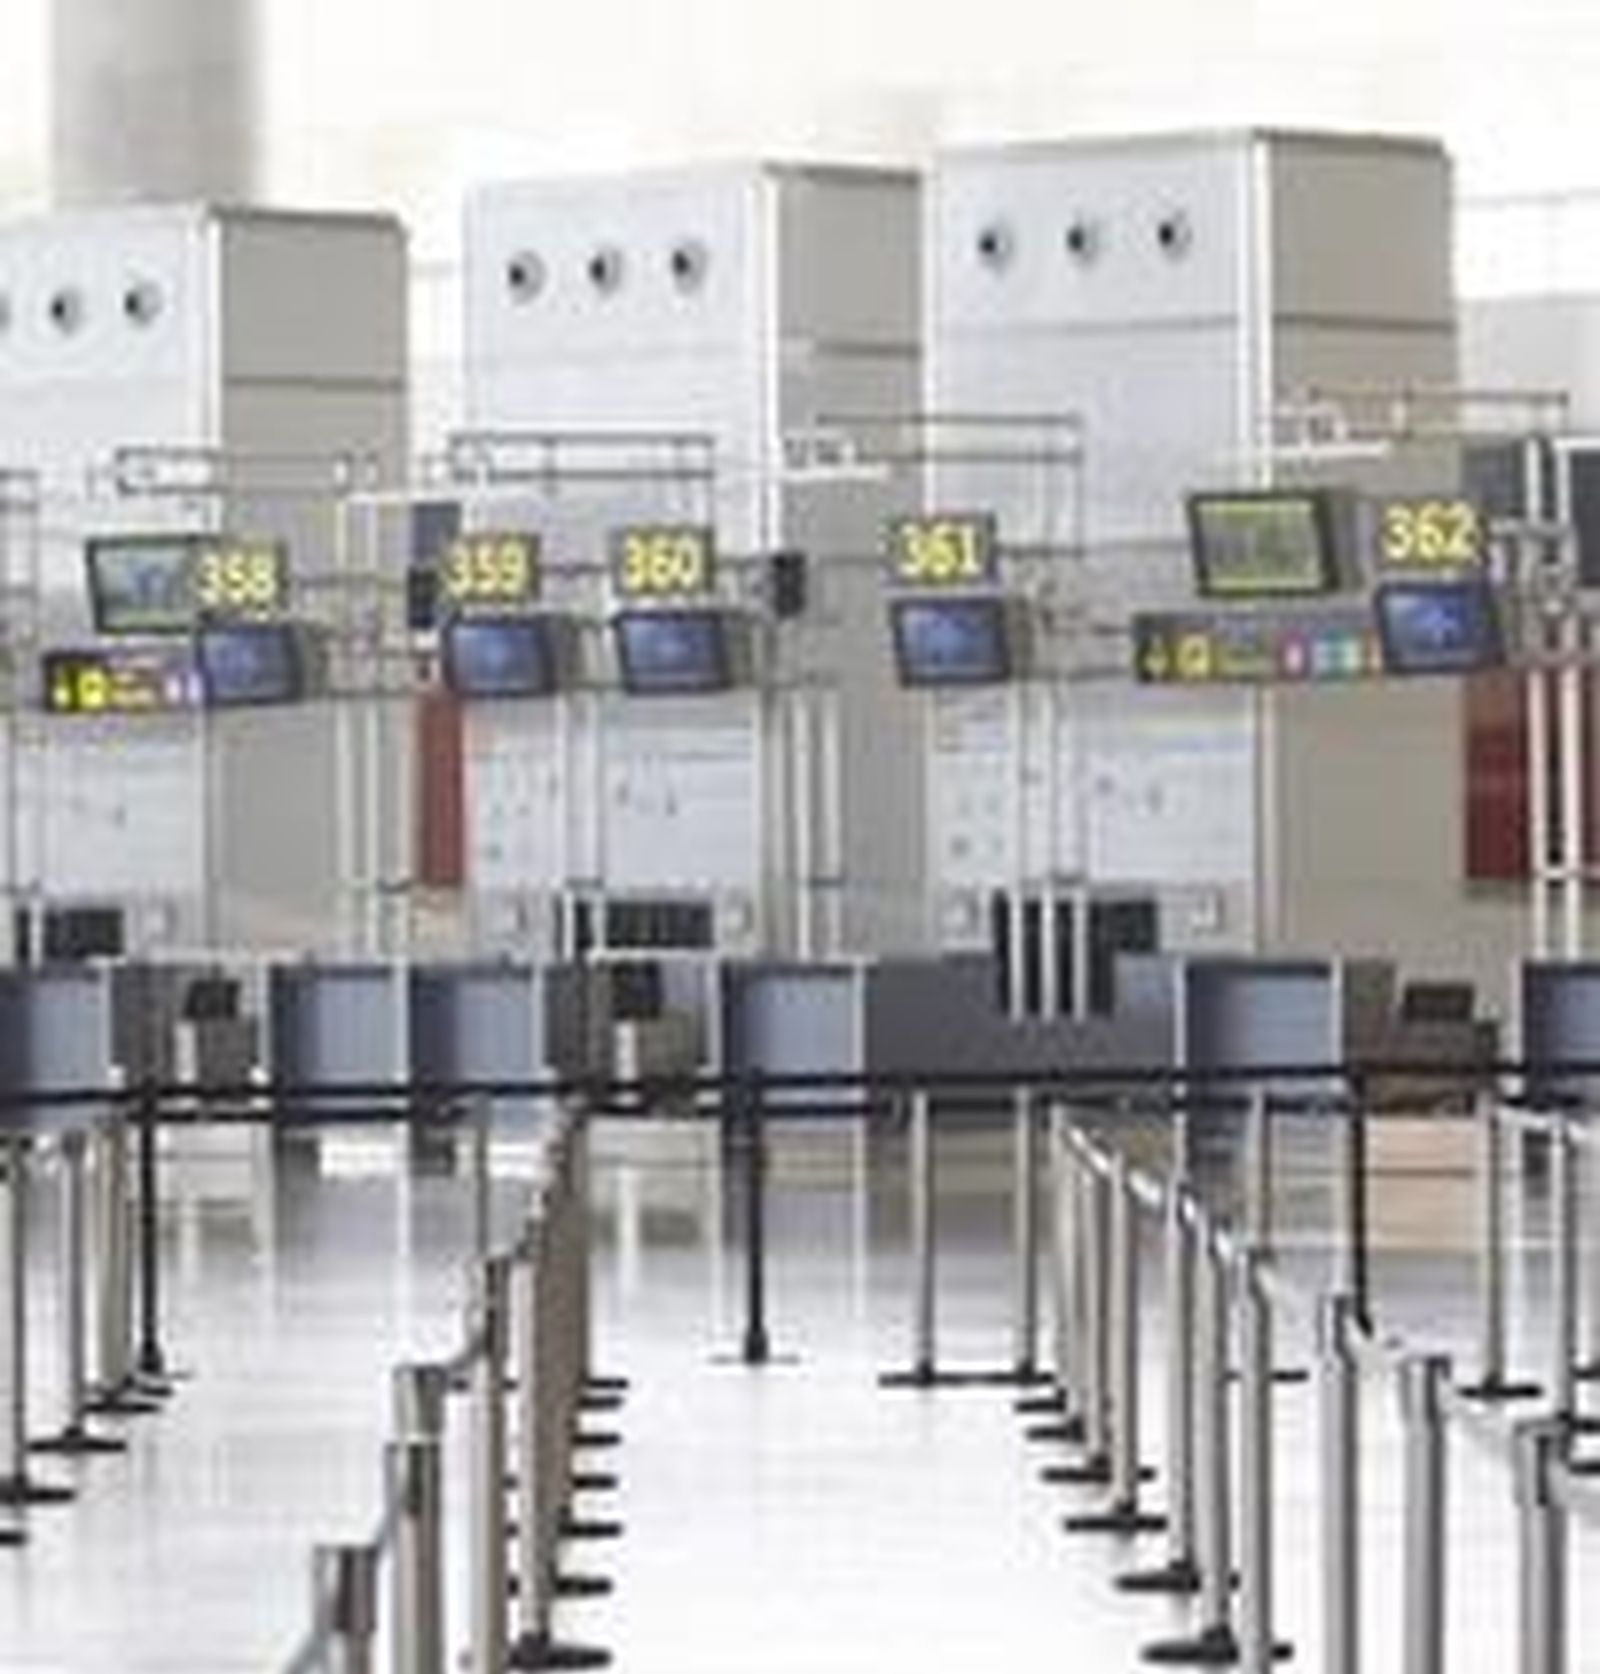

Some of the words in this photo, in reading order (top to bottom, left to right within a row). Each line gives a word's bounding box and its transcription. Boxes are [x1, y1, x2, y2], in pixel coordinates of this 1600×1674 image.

[898, 522, 981, 576] 361
[1383, 502, 1480, 560] 362
[197, 552, 276, 605] 358
[446, 541, 527, 595] 359
[622, 534, 702, 588] 360
